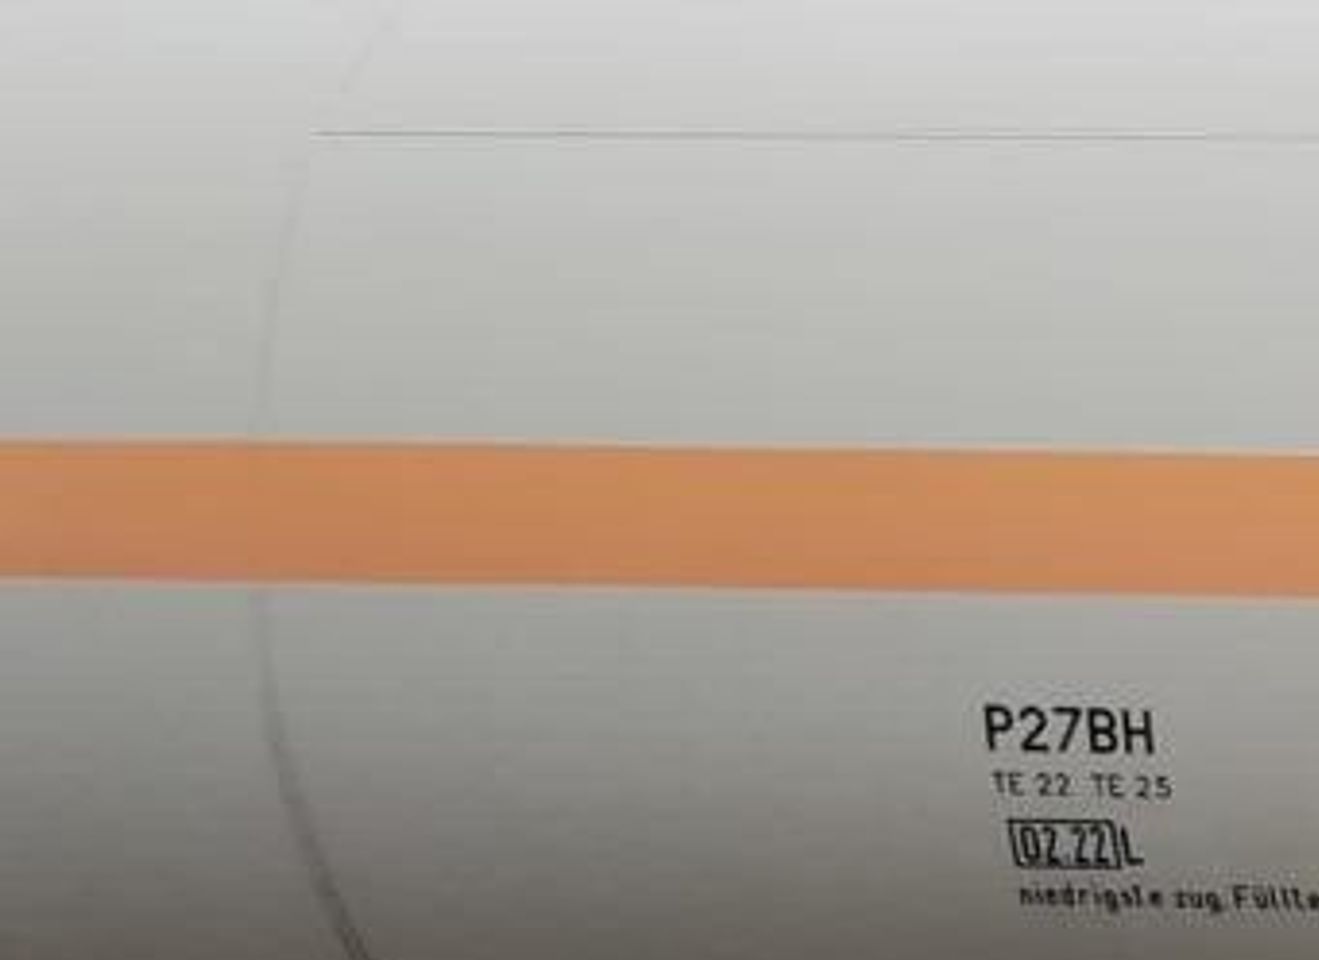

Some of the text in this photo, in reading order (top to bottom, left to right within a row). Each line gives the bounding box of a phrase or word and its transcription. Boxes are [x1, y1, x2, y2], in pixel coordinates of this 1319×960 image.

[983, 705, 1155, 754] P27BH
[992, 771, 1173, 799] TE 22 TE 25
[1120, 827, 1145, 866] L
